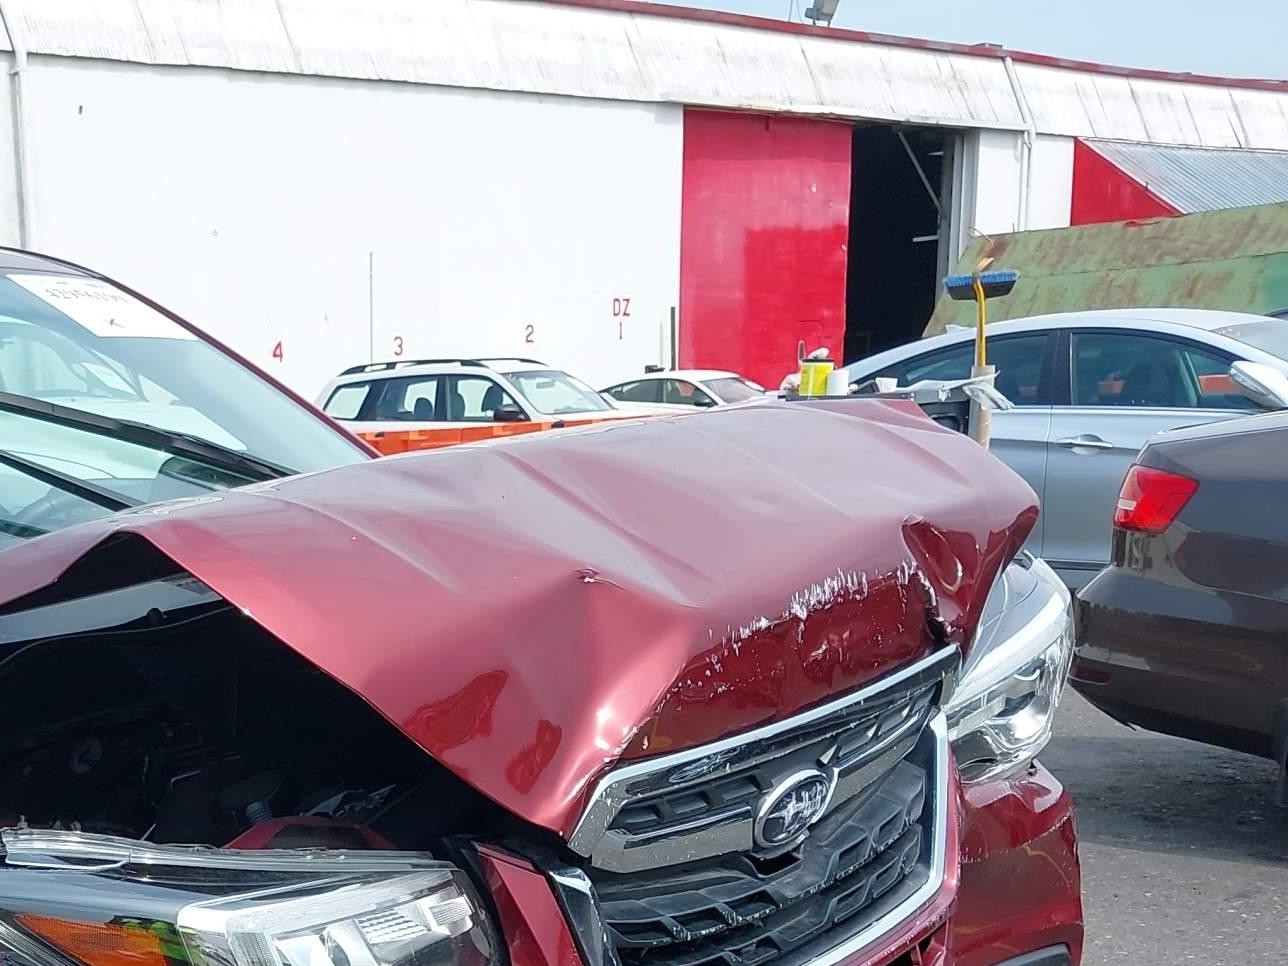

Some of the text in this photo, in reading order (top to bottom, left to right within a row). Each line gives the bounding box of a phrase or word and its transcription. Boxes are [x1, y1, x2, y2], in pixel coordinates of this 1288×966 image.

[613, 297, 631, 317] DZ
[525, 324, 535, 343] 2
[272, 340, 284, 363] 4
[393, 336, 404, 356] 3
